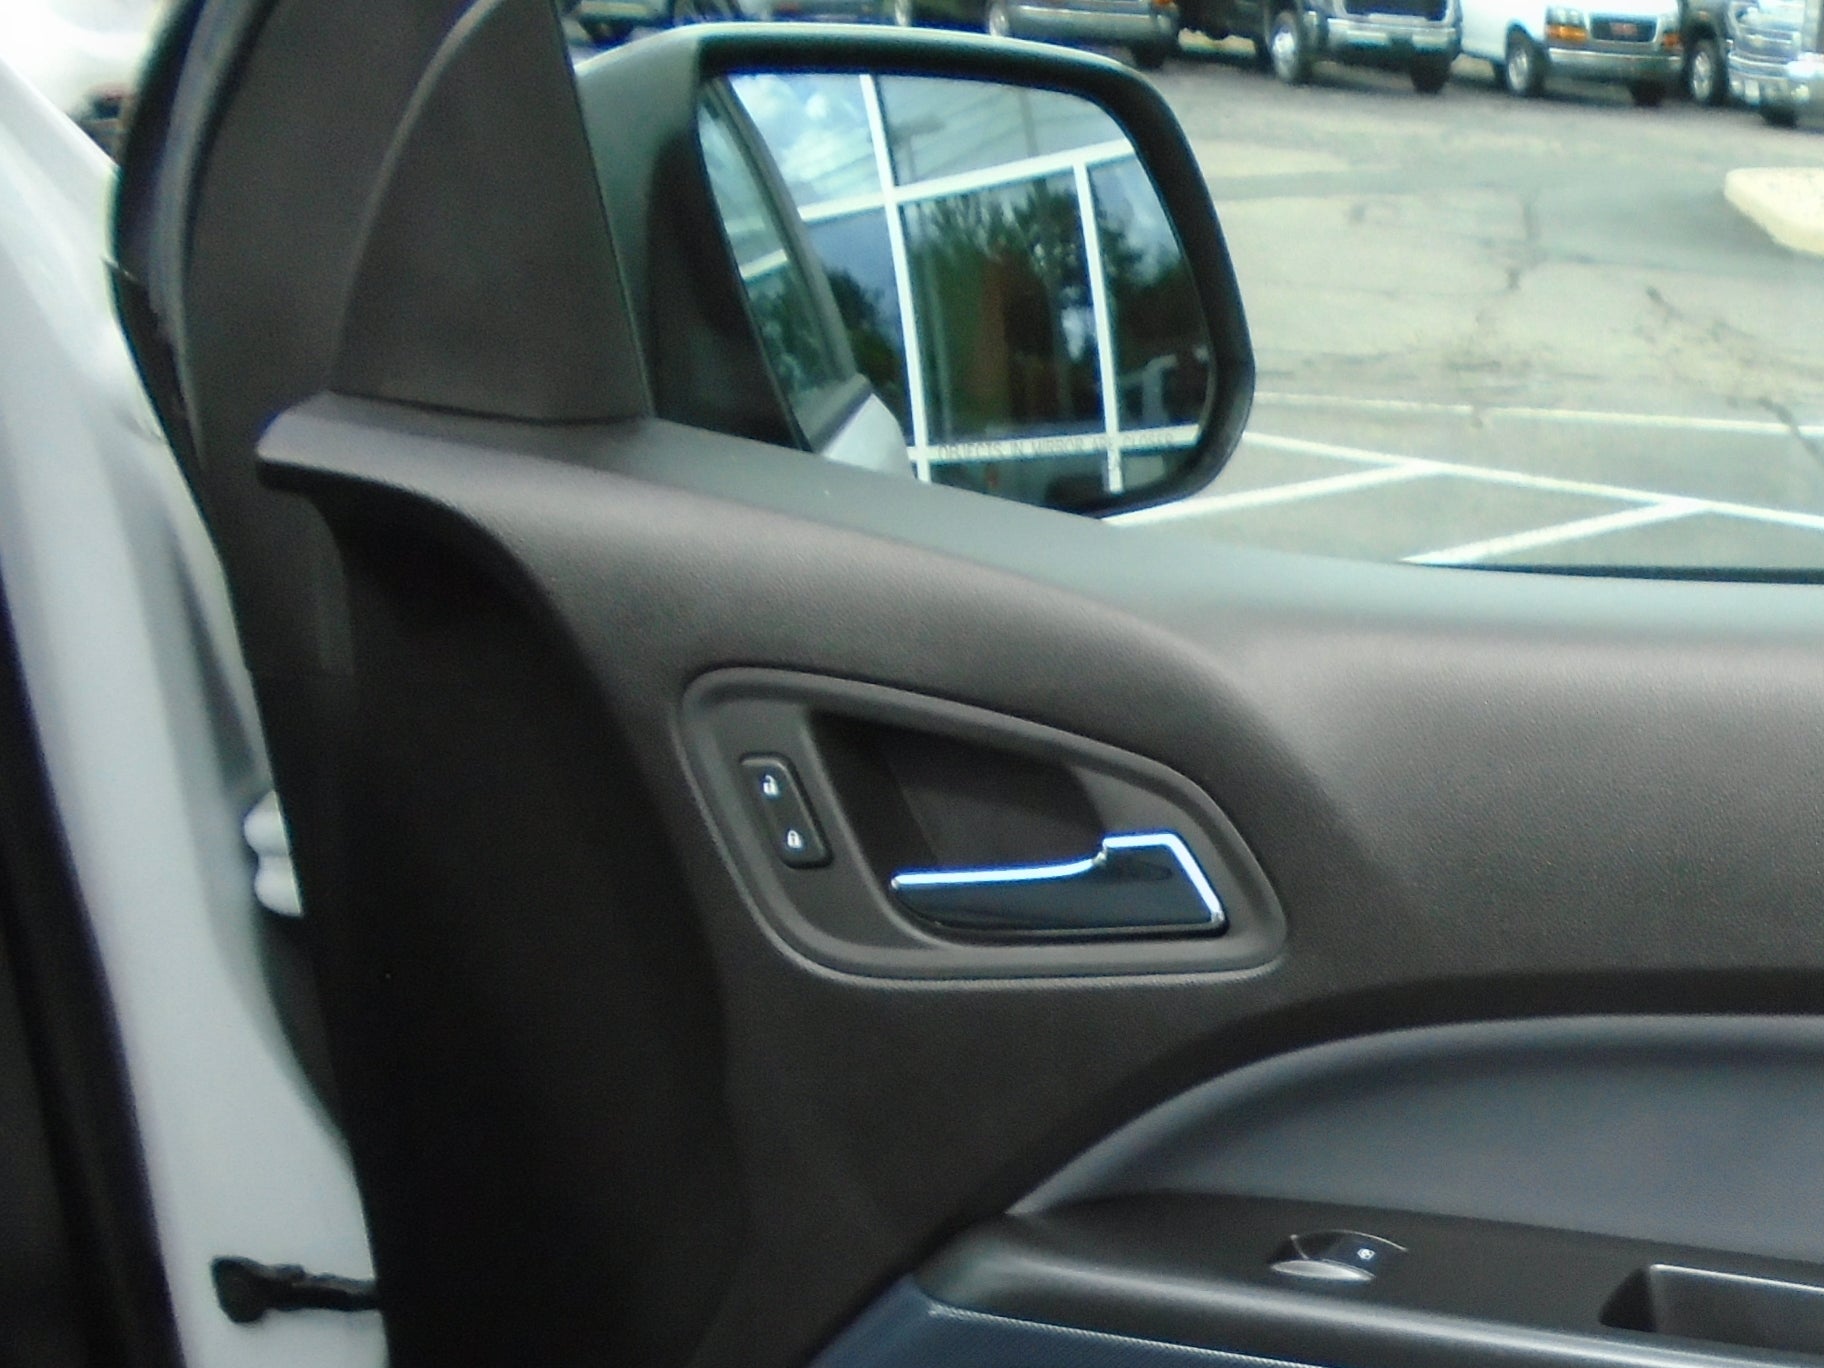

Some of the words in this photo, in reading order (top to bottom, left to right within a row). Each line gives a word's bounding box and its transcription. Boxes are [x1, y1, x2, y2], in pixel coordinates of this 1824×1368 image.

[938, 442, 1004, 460] OBJECTS
[1009, 440, 1026, 456] IN
[1030, 437, 1085, 456] MIRROR
[1122, 431, 1174, 448] CLOSER
